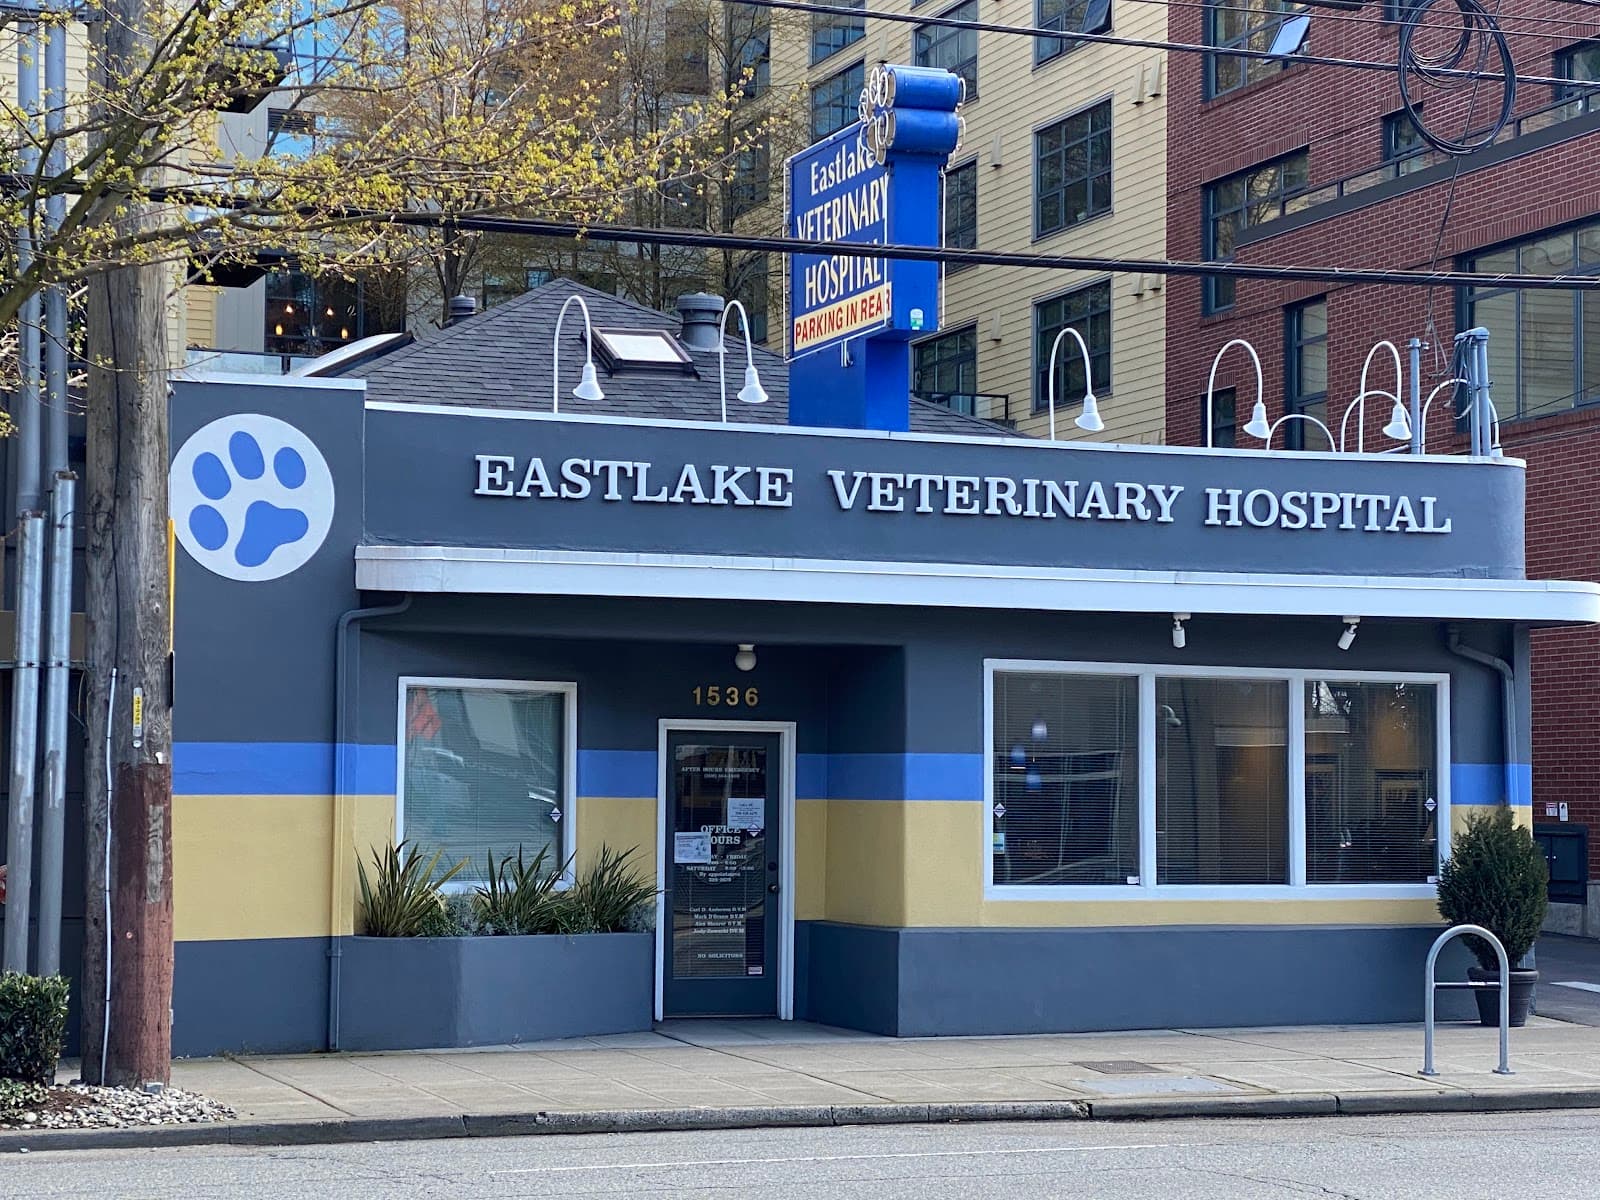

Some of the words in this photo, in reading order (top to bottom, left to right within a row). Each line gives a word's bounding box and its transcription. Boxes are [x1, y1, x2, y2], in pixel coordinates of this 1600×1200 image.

[810, 136, 875, 197] Eastlake
[796, 171, 888, 253] VETERINARY
[795, 307, 843, 345] PARKING
[846, 301, 858, 327] IN
[860, 288, 890, 321] REAR
[474, 454, 794, 508] EASTLAKE
[827, 470, 1185, 523] VETERINARY
[1204, 487, 1452, 534] HOSPITAL
[692, 686, 759, 707] 1536
[700, 825, 742, 834] OFFICE
